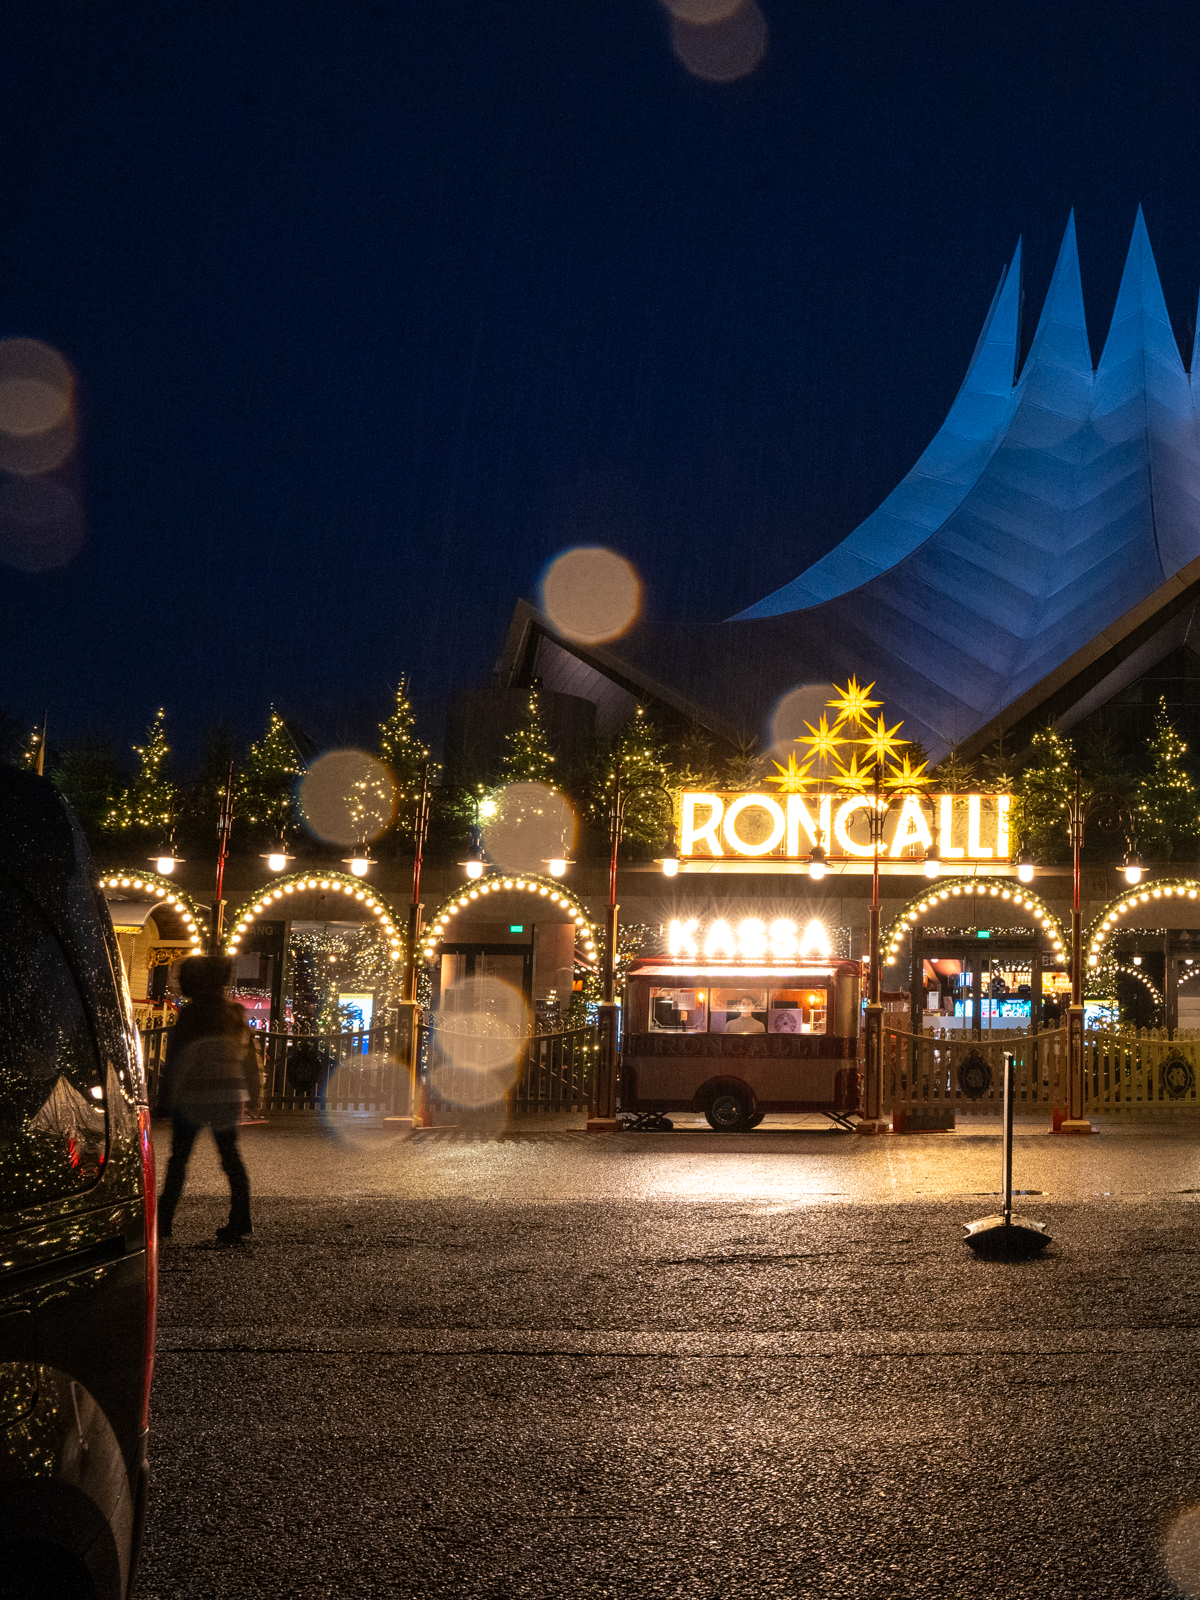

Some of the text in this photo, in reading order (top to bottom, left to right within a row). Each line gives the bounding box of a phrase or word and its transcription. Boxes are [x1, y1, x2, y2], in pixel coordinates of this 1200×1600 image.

[681, 793, 1011, 857] RONCALLI
[669, 918, 833, 957] KASSA
[653, 1036, 822, 1056] RONCALLI
